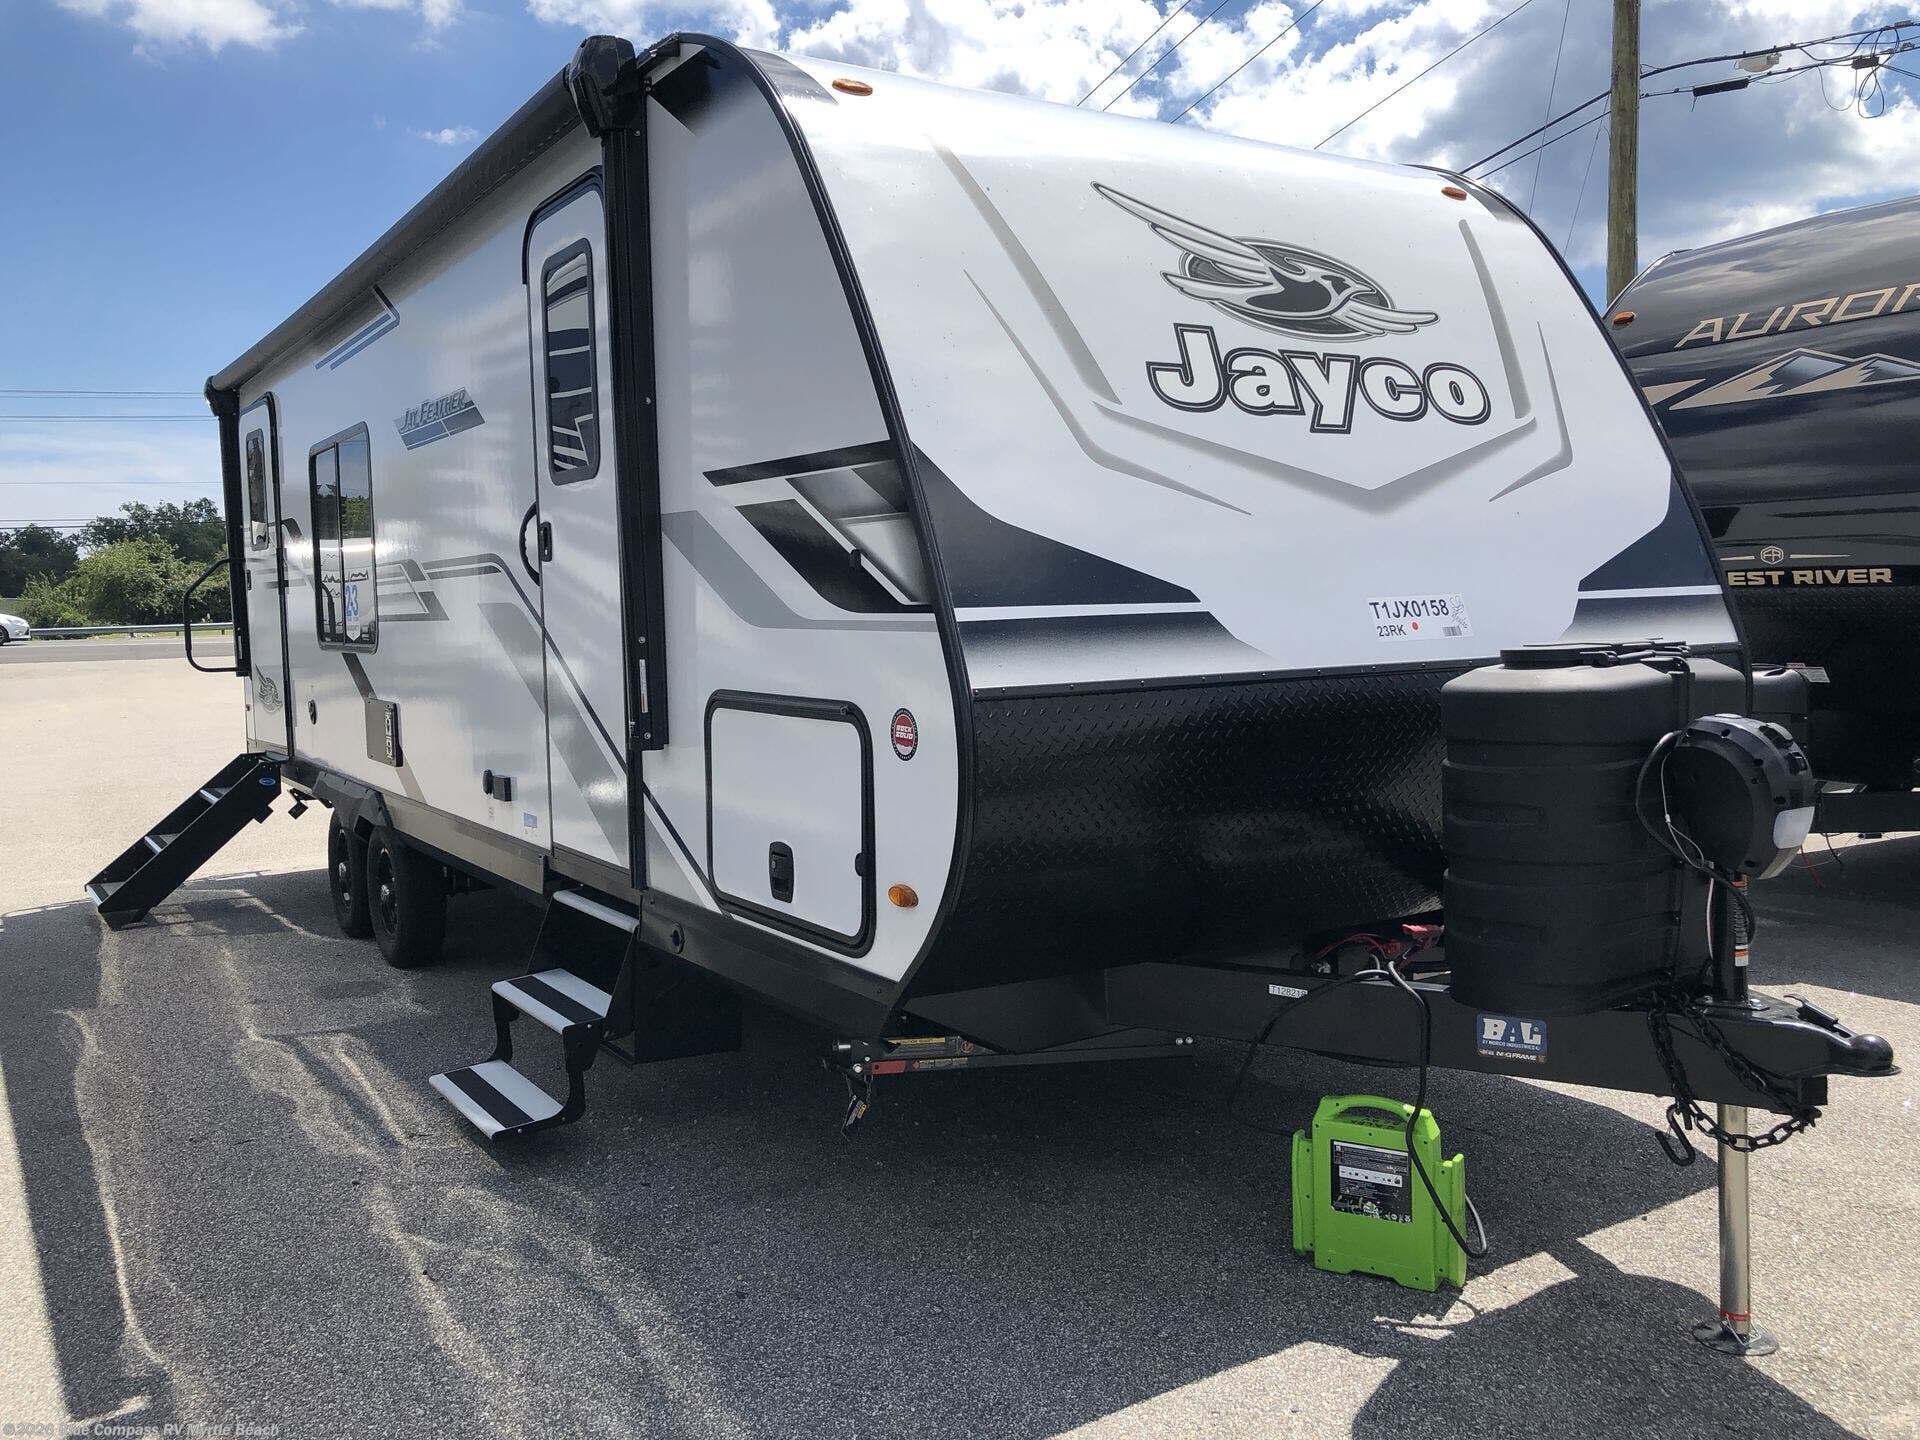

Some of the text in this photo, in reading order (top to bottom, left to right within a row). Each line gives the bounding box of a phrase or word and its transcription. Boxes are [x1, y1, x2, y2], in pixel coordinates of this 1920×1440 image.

[1146, 323, 1492, 434] Jayco
[1791, 568, 1893, 584] RIVER
[1369, 599, 1449, 619] T1JX0158
[1377, 624, 1407, 637] 23RK
[896, 725, 912, 733] ROCK
[896, 731, 913, 739] SOLID
[1483, 1018, 1542, 1045] BAL
